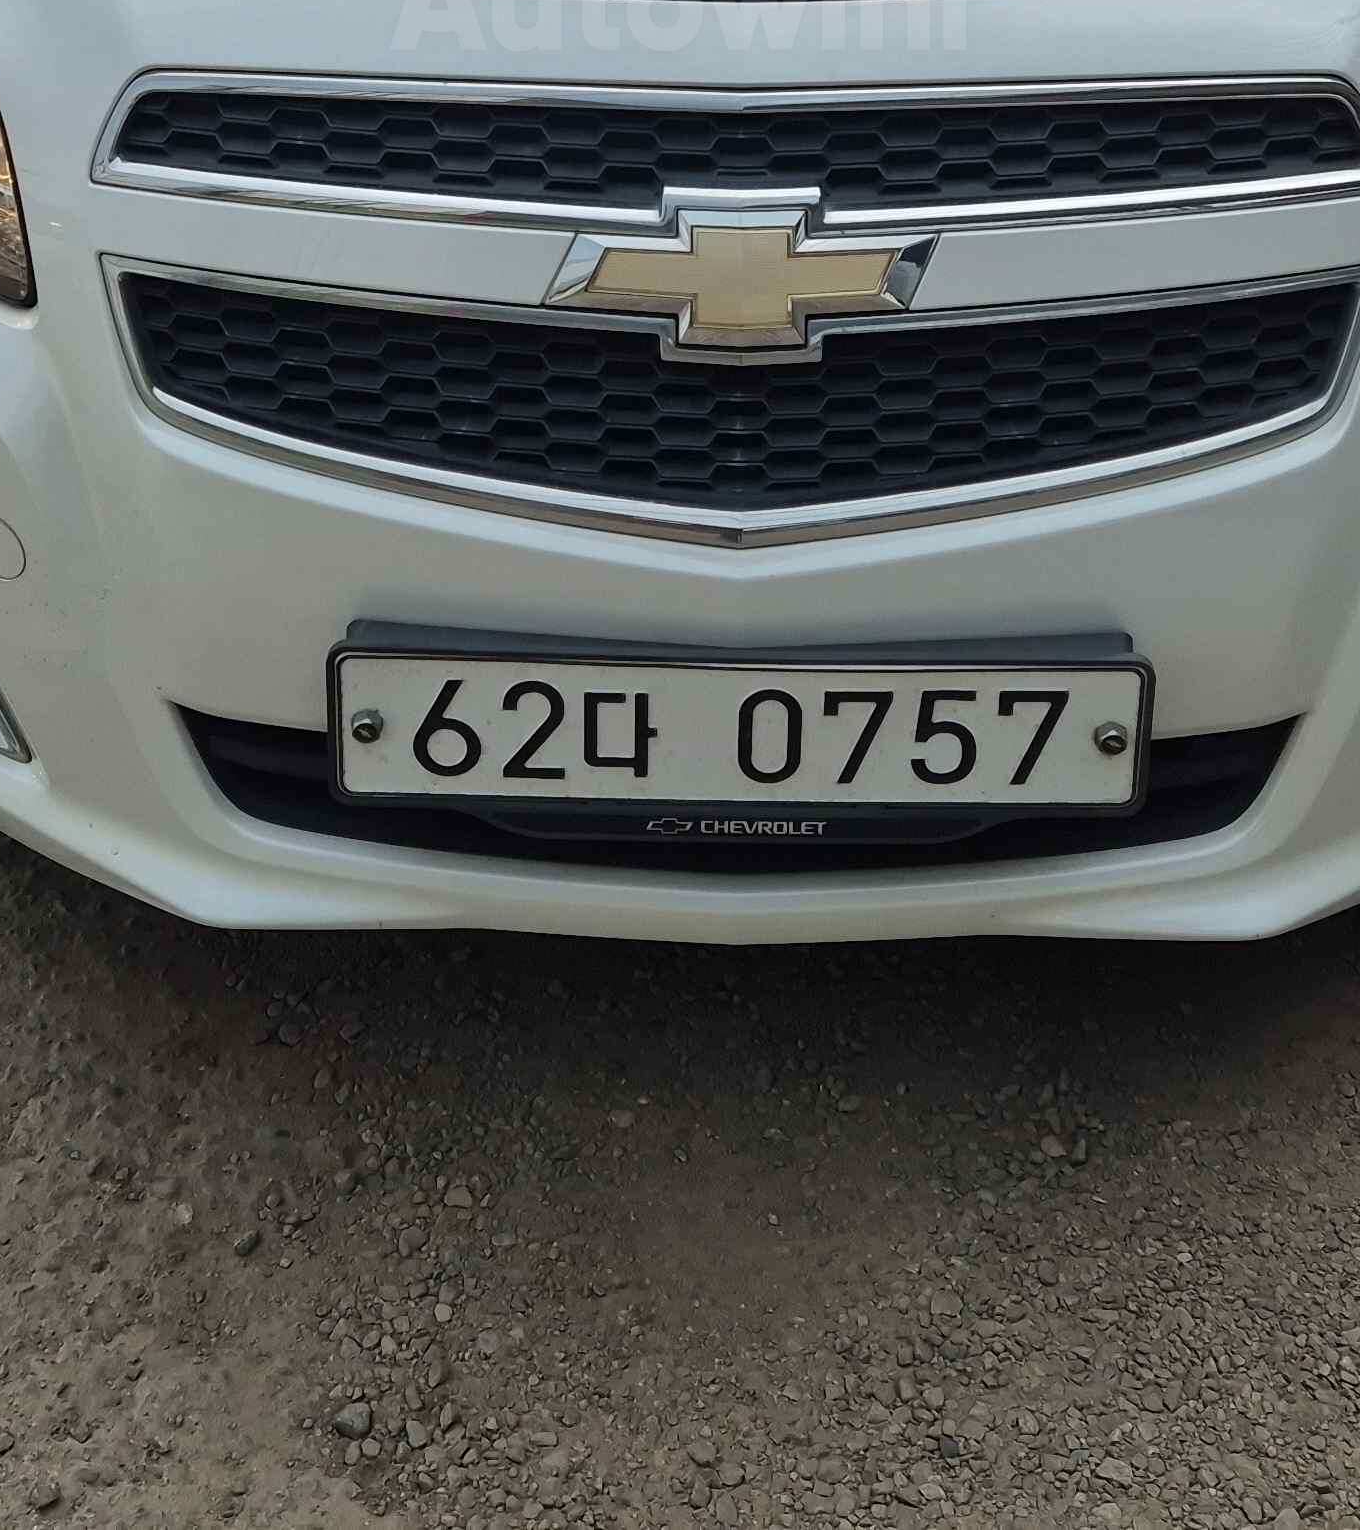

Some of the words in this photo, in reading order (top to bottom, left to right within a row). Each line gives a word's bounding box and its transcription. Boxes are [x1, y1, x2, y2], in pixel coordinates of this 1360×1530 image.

[410, 678, 659, 779] 62다
[737, 688, 1070, 785] 0757
[700, 819, 827, 836] CHEVROLET
